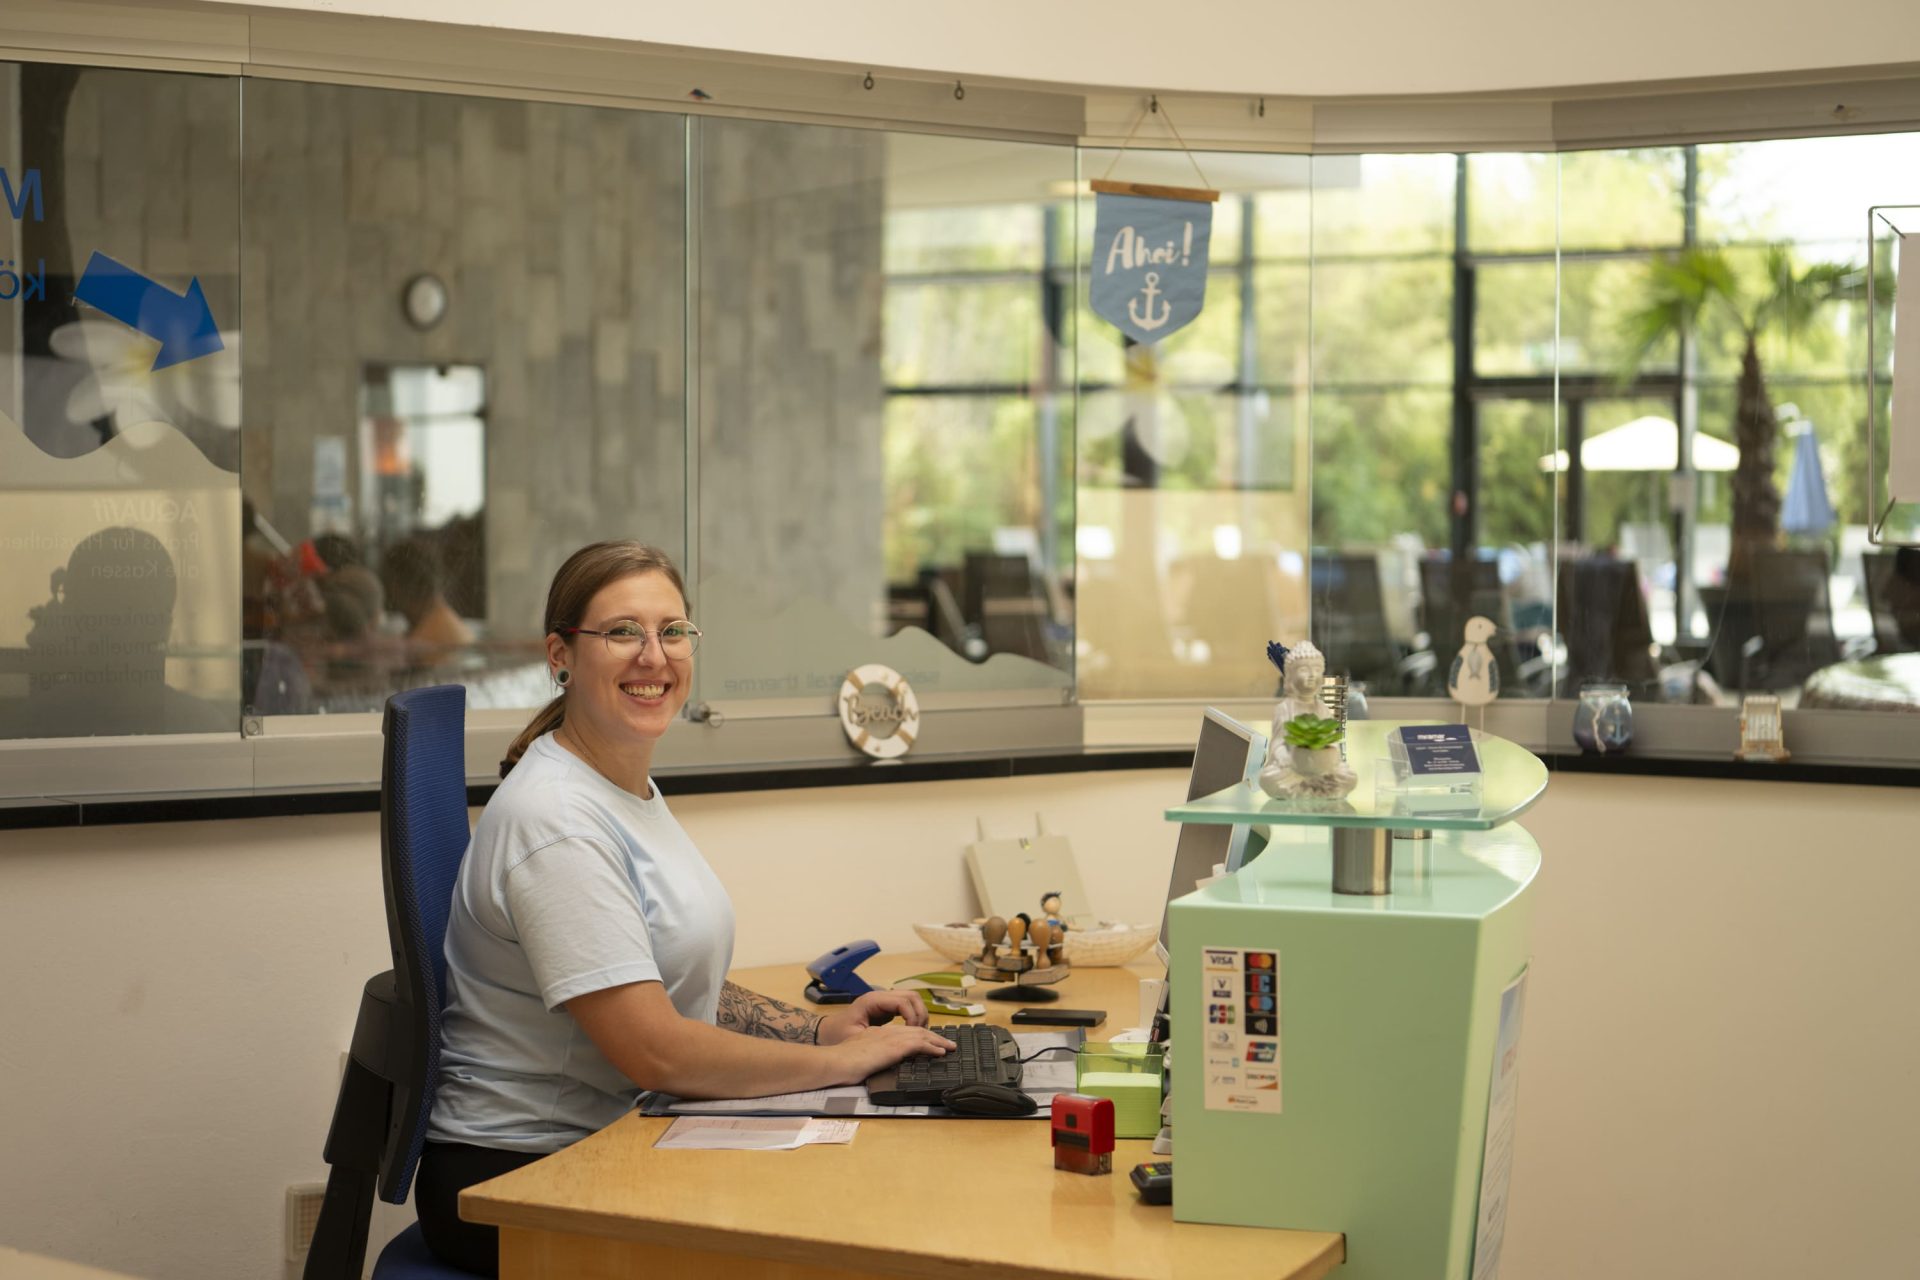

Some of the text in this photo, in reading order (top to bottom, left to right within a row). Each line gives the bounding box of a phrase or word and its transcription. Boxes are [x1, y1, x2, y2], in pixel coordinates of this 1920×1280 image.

[1105, 221, 1194, 275] Ahoi!
[843, 694, 919, 726] Beach
[1210, 955, 1234, 966] VISA
